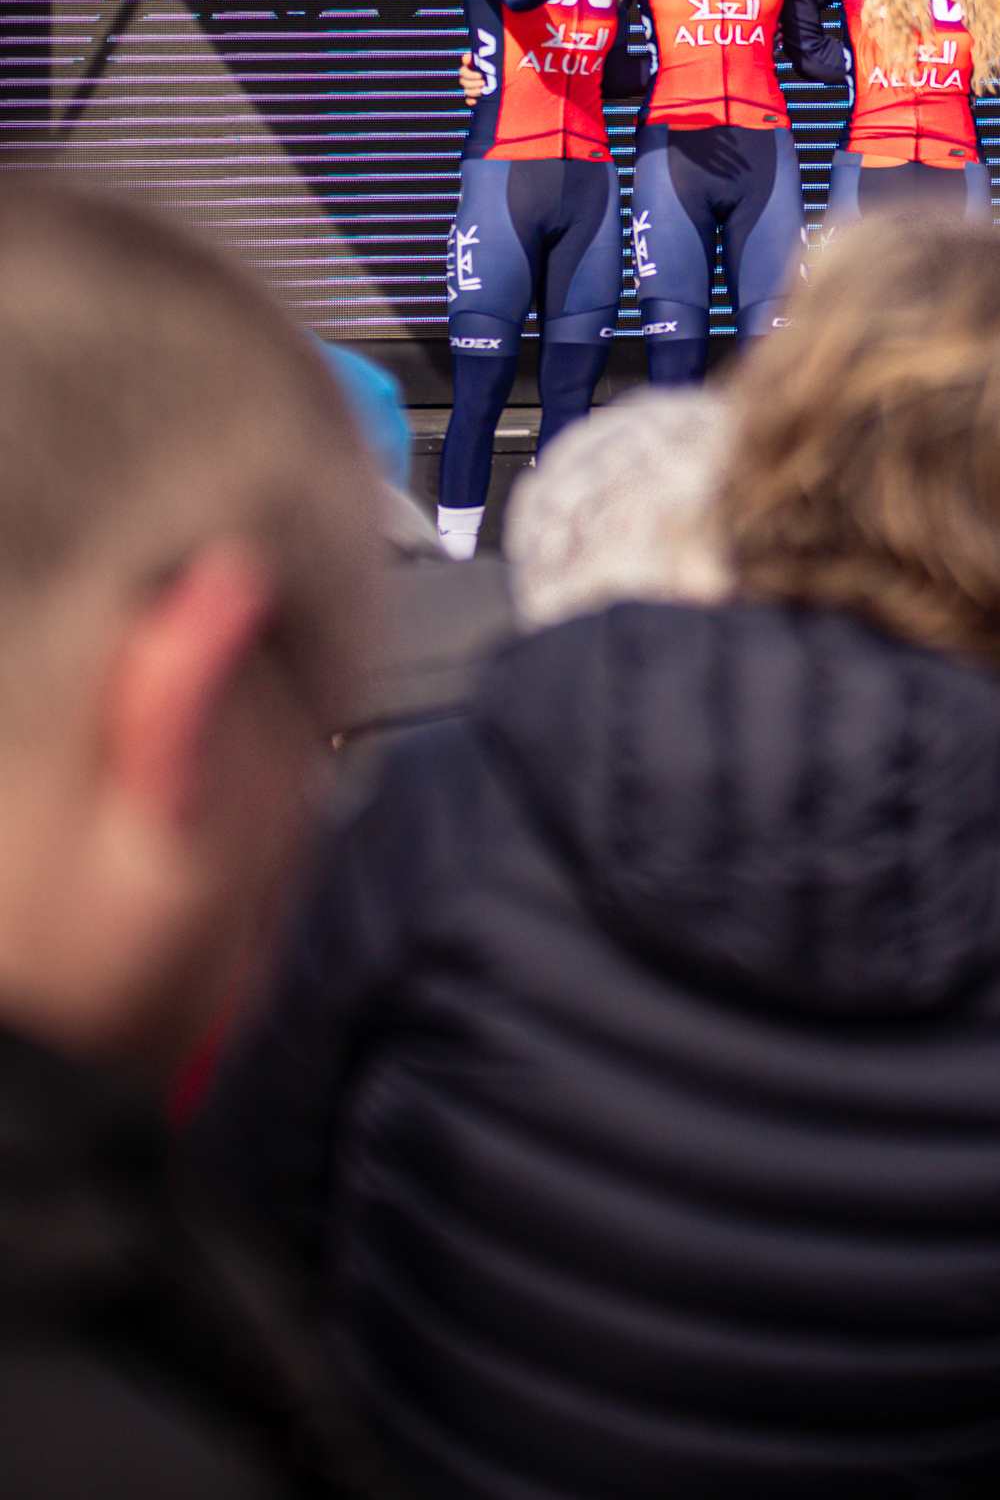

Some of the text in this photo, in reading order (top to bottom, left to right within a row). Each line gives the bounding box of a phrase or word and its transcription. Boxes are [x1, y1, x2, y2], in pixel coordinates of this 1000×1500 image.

[673, 24, 766, 48] ALULA
[516, 50, 604, 75] ALULA
[867, 66, 964, 91] ALULA
